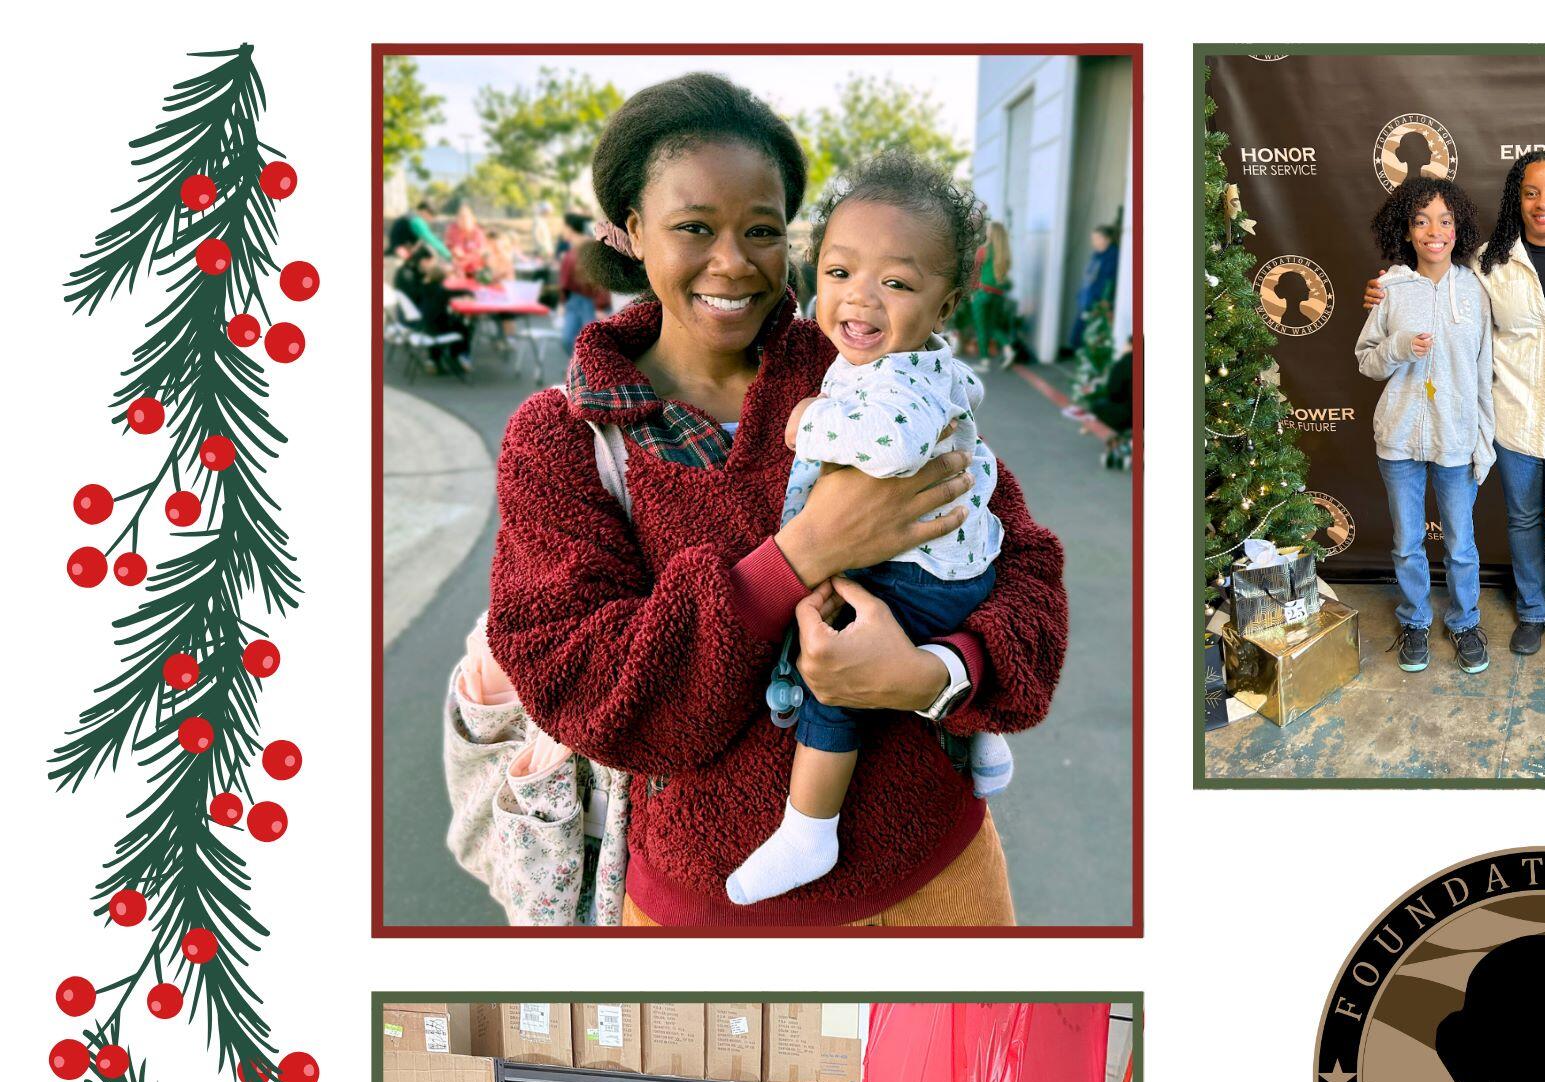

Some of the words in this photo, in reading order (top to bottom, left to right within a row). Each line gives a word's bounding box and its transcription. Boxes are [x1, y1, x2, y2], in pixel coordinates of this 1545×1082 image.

[1376, 115, 1434, 149] FOUNDATION
[1437, 127, 1453, 147] FOR
[1240, 147, 1317, 162] HONOR
[1243, 165, 1267, 176] HER
[1270, 164, 1317, 176] SERVICE
[1255, 257, 1311, 287] FOUNDATION
[1314, 264, 1330, 285] FOR
[1257, 306, 1287, 334] WOMEN
[1292, 304, 1333, 335] WARRIORS
[1297, 422, 1337, 432] FUTURE
